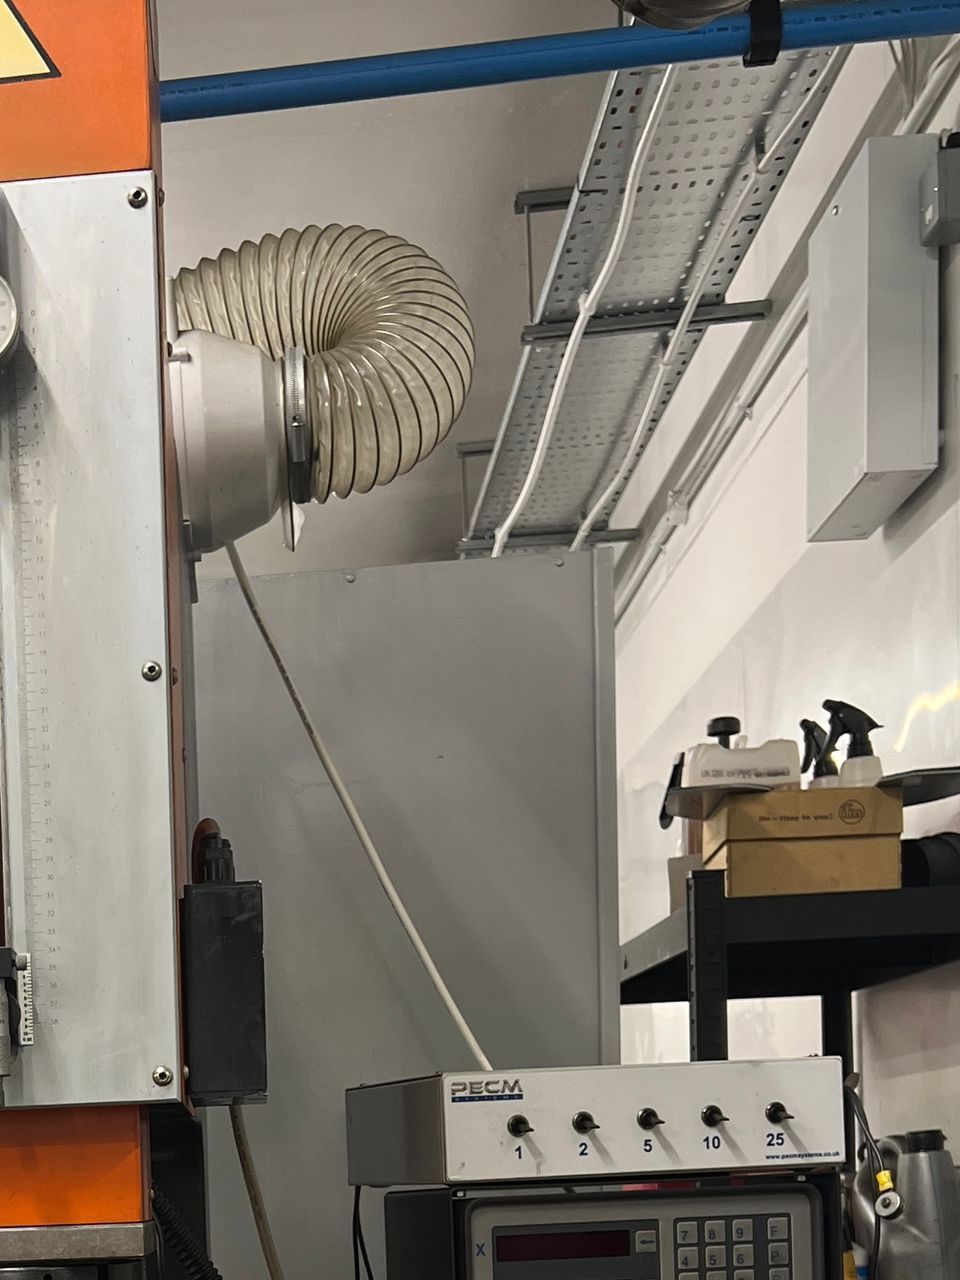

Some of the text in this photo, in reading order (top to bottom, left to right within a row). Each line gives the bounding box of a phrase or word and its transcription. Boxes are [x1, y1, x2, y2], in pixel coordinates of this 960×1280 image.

[450, 1078, 524, 1096] PECM
[514, 1132, 785, 1160] 1 2 5 10 25
[679, 1225, 779, 1242] 7 8 9 F
[475, 1242, 486, 1257] X
[681, 1255, 689, 1267] 4
[709, 1254, 717, 1266] 5
[736, 1253, 744, 1265] 6
